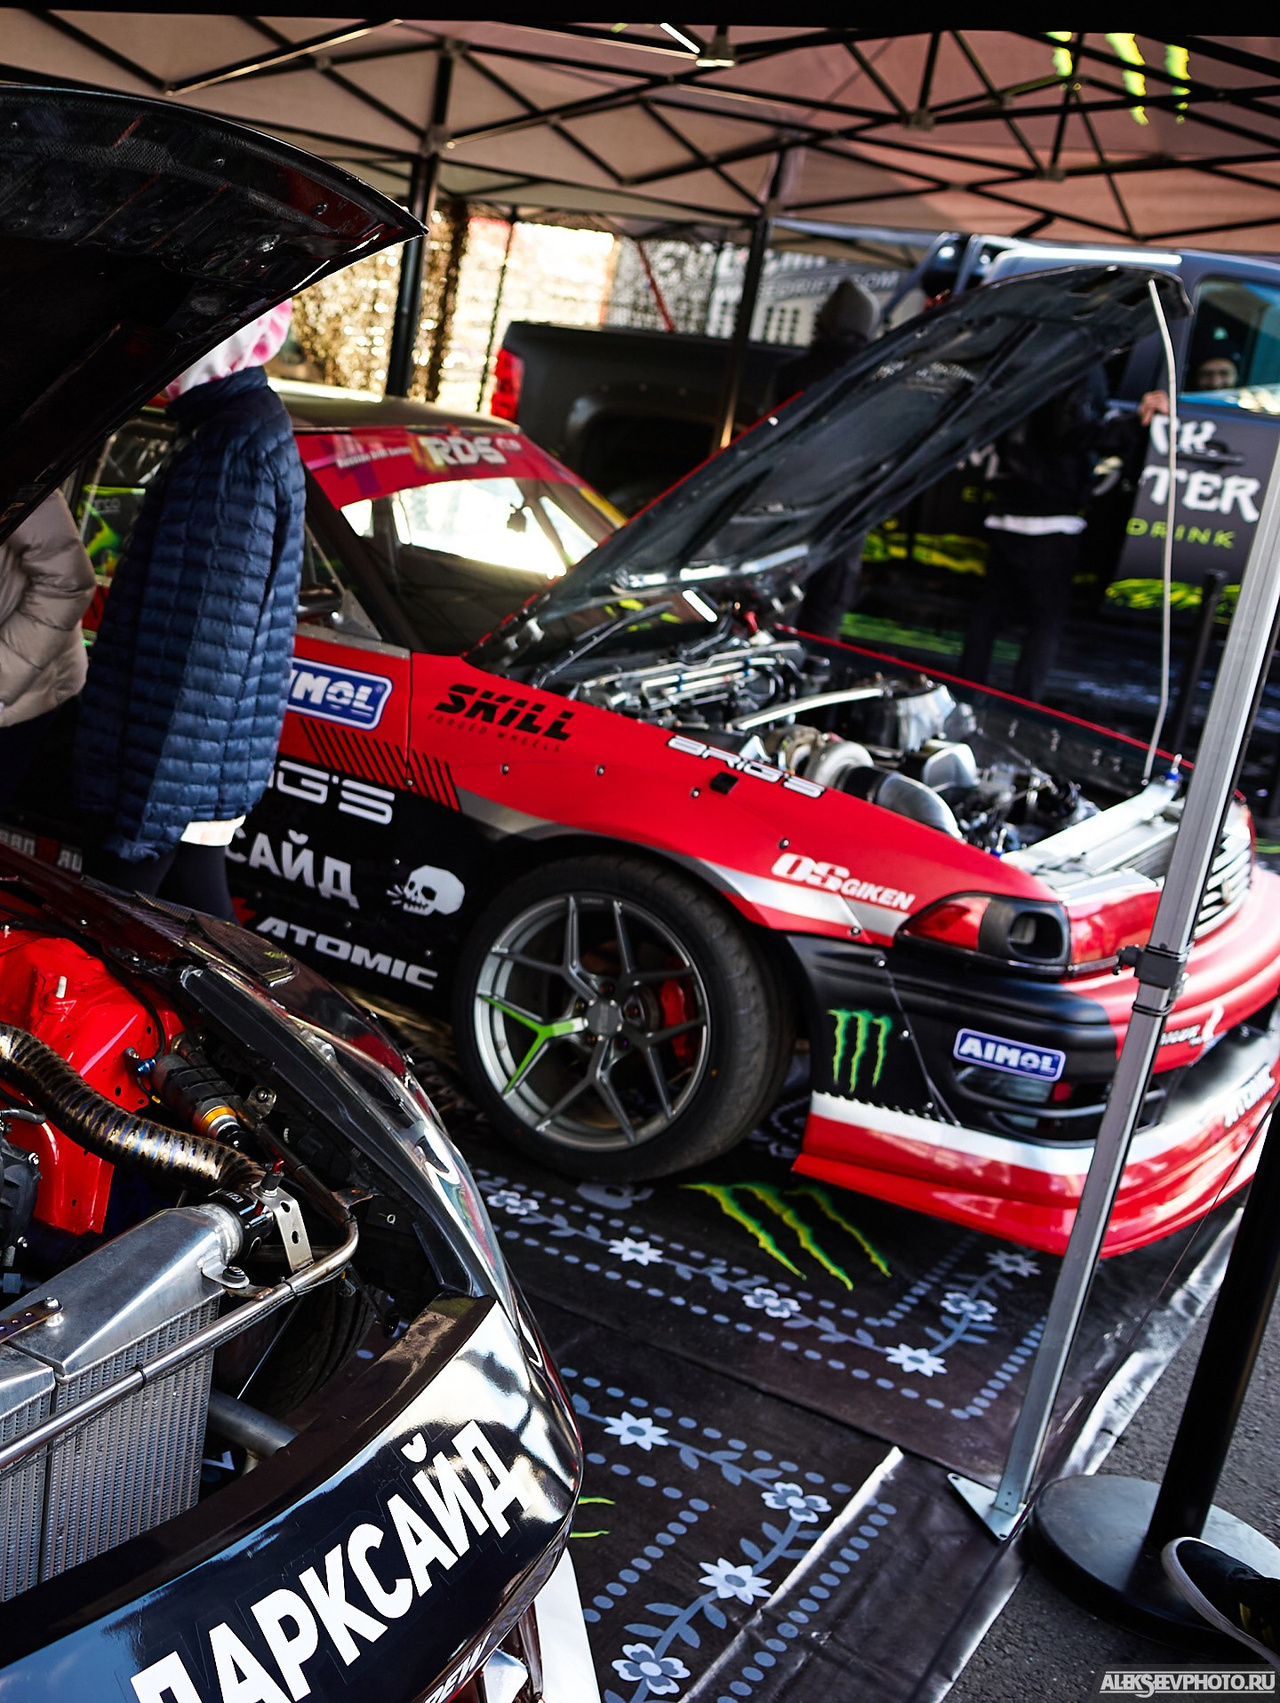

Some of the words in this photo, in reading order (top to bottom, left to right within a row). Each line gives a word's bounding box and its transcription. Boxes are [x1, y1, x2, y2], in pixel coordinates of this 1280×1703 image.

[418, 437, 507, 465] RDS
[1126, 517, 1236, 549] DRINK
[771, 852, 851, 892] OS
[840, 877, 917, 911] GIKEN
[256, 916, 439, 990] ATOMIC
[959, 1036, 1058, 1074] AIMOL
